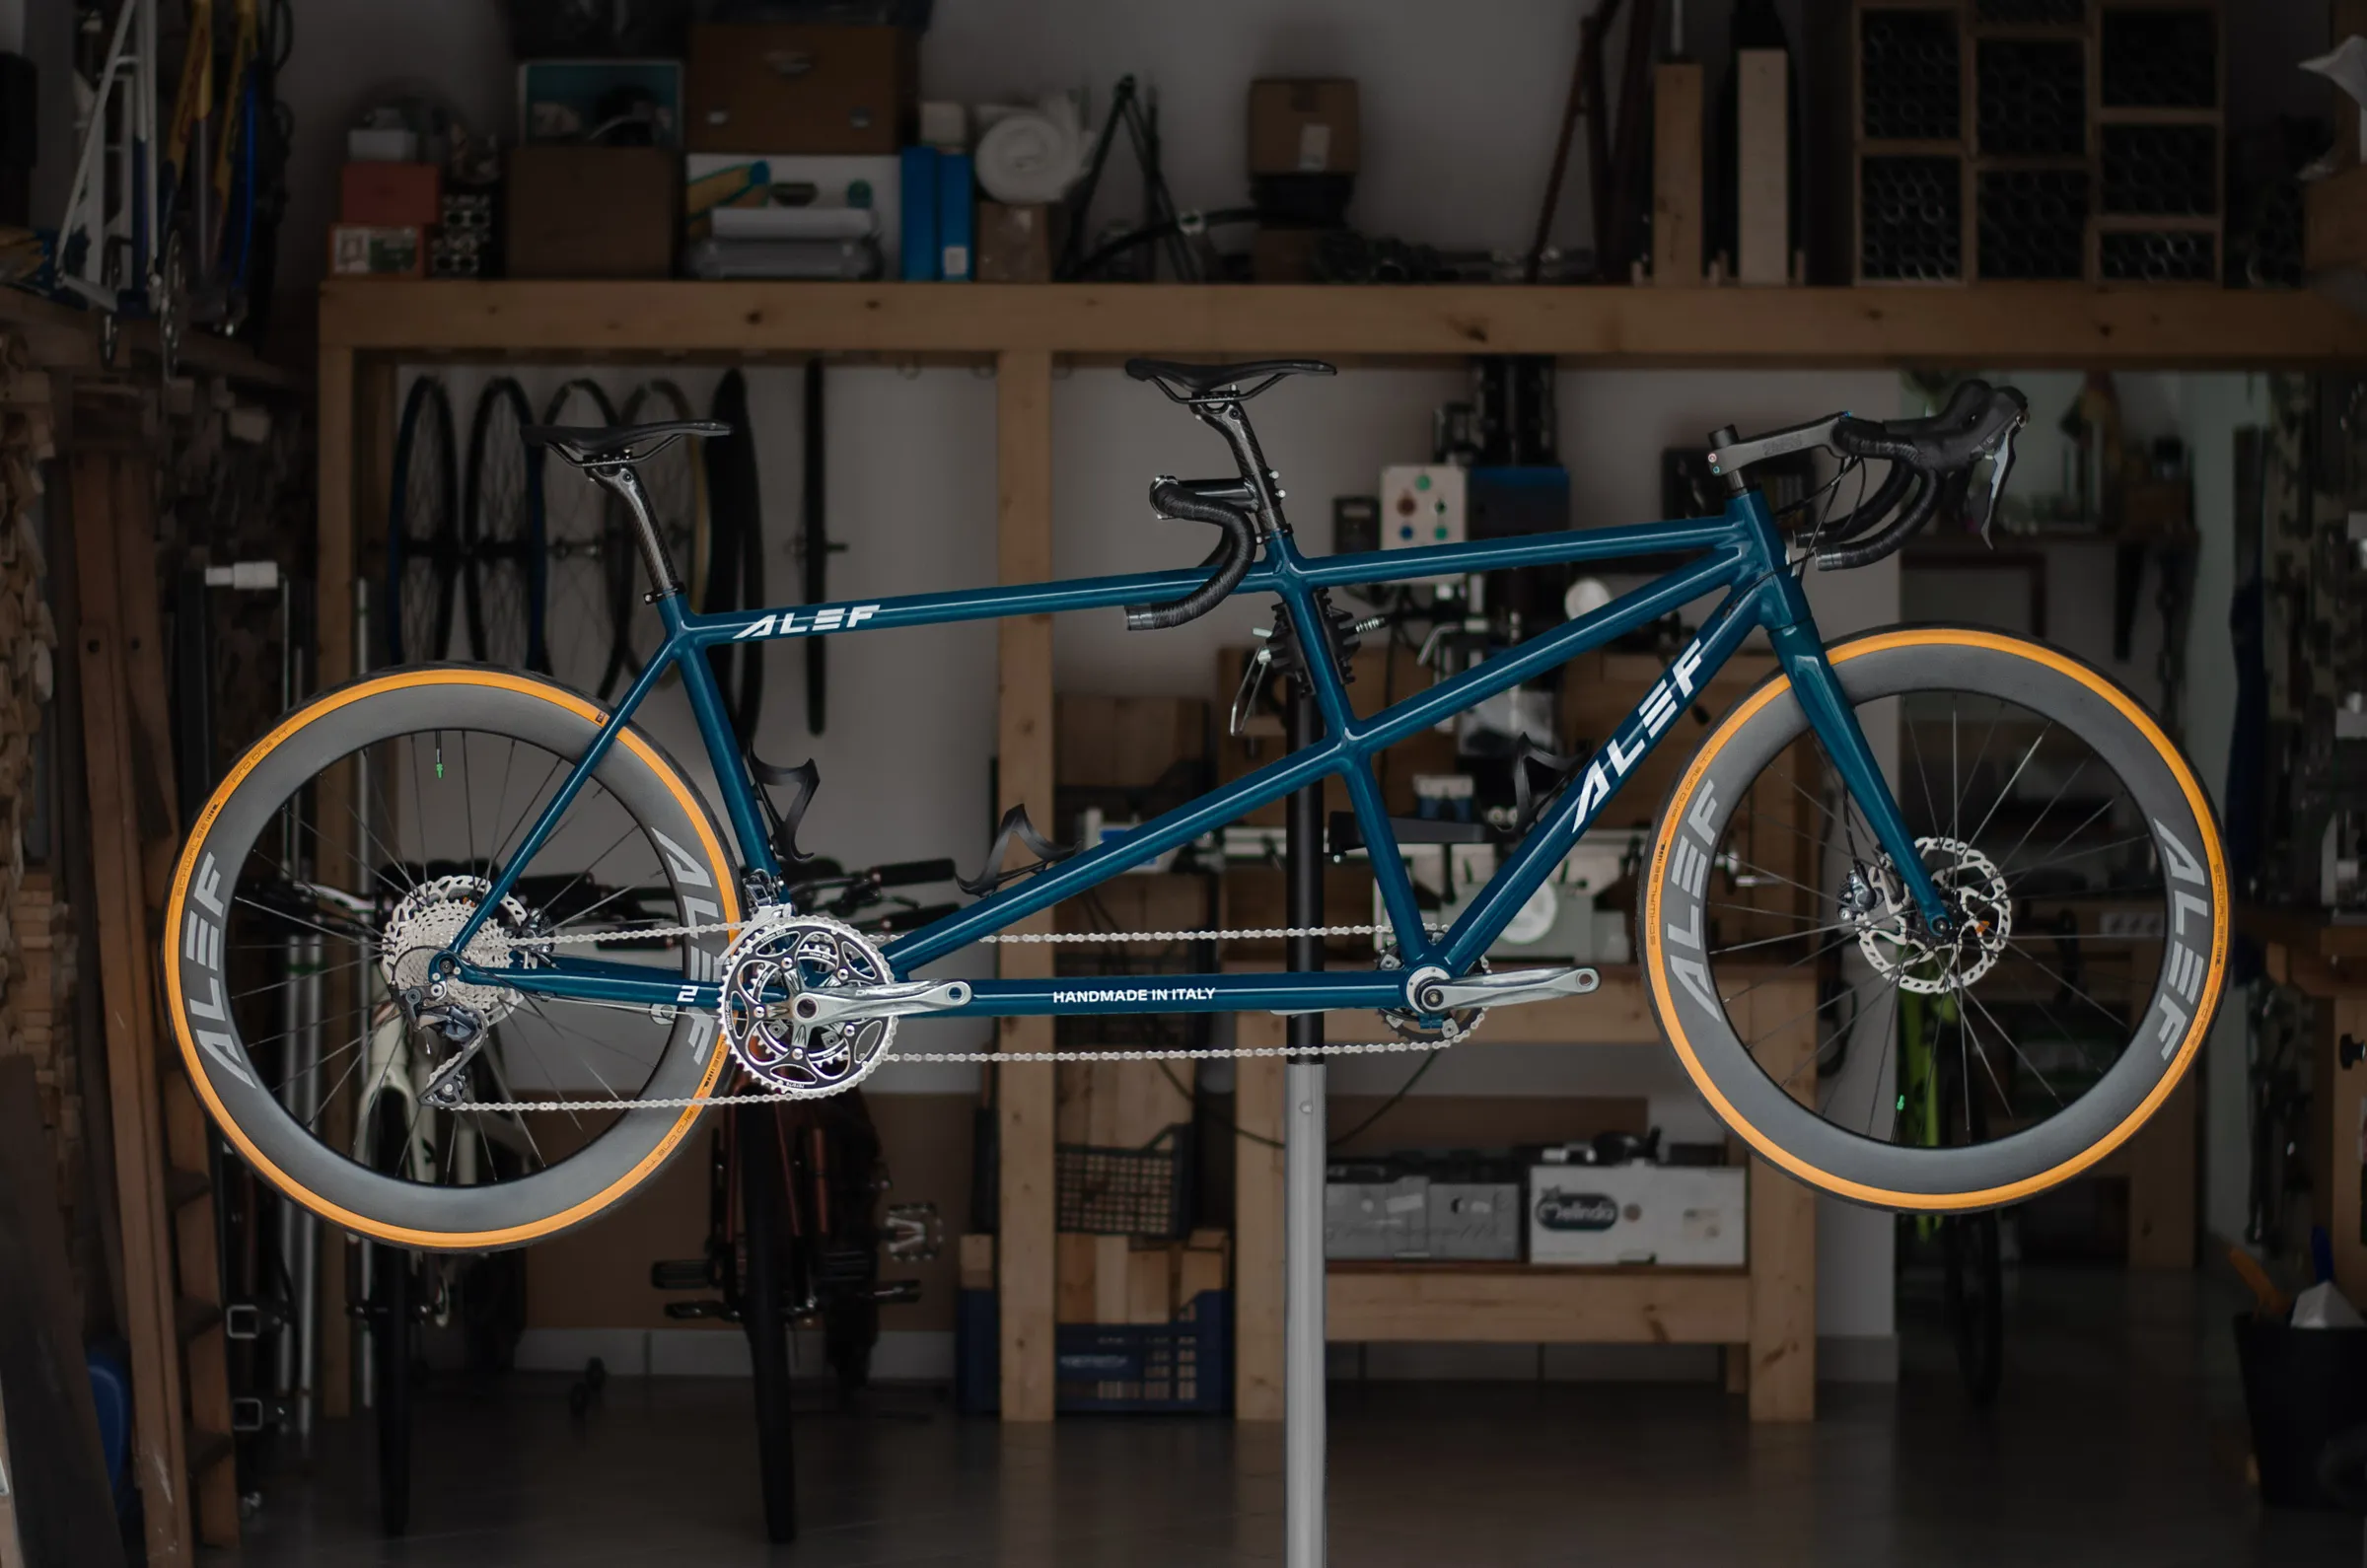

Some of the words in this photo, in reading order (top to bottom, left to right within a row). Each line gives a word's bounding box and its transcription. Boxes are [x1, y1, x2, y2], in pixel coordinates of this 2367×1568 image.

[732, 604, 881, 639] ALEF
[1572, 637, 1702, 833] ALEF
[186, 851, 257, 1089] ALEF
[651, 826, 722, 1065] ALEF
[1052, 989, 1148, 1003] HANDMADE
[1152, 988, 1168, 1001] IN
[1172, 987, 1216, 1001] ITALY
[1650, 862, 1662, 947] SCHWALBE
[1667, 779, 1722, 1023] ALEF
[2153, 818, 2208, 1061] ALEF
